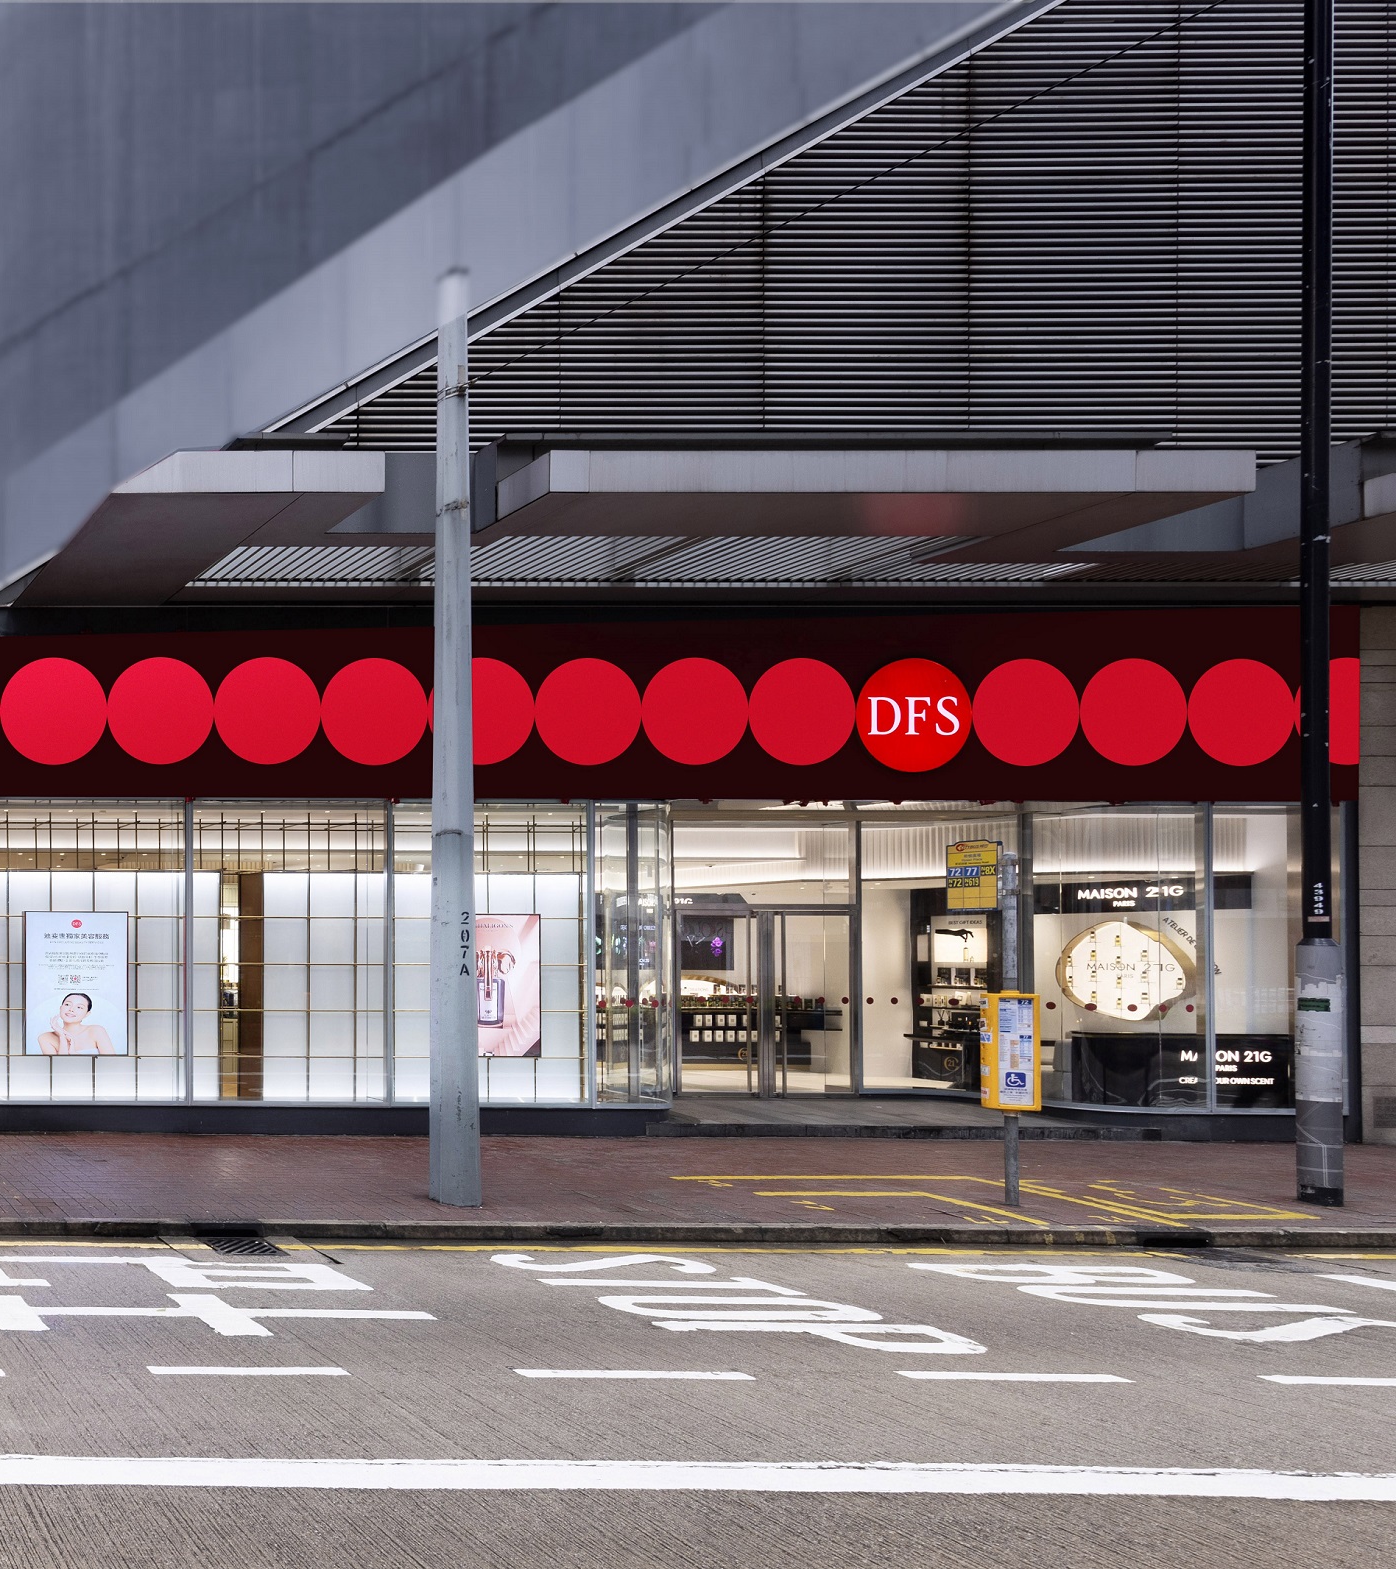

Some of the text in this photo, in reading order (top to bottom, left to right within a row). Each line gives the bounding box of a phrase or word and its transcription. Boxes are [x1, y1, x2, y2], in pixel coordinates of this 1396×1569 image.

[867, 695, 960, 736] DFS
[949, 868, 961, 876] 72
[966, 867, 978, 876] 77
[1077, 886, 1184, 900] MAISON 21G
[1162, 917, 1189, 938] ATELIER
[459, 911, 470, 976] 207A
[1087, 962, 1176, 972] MAISON 21G
[1180, 1050, 1272, 1062] MAON 21G
[1215, 1064, 1238, 1072] PARIS
[489, 1253, 988, 1355] STOP
[906, 1261, 1396, 1344] BUS
